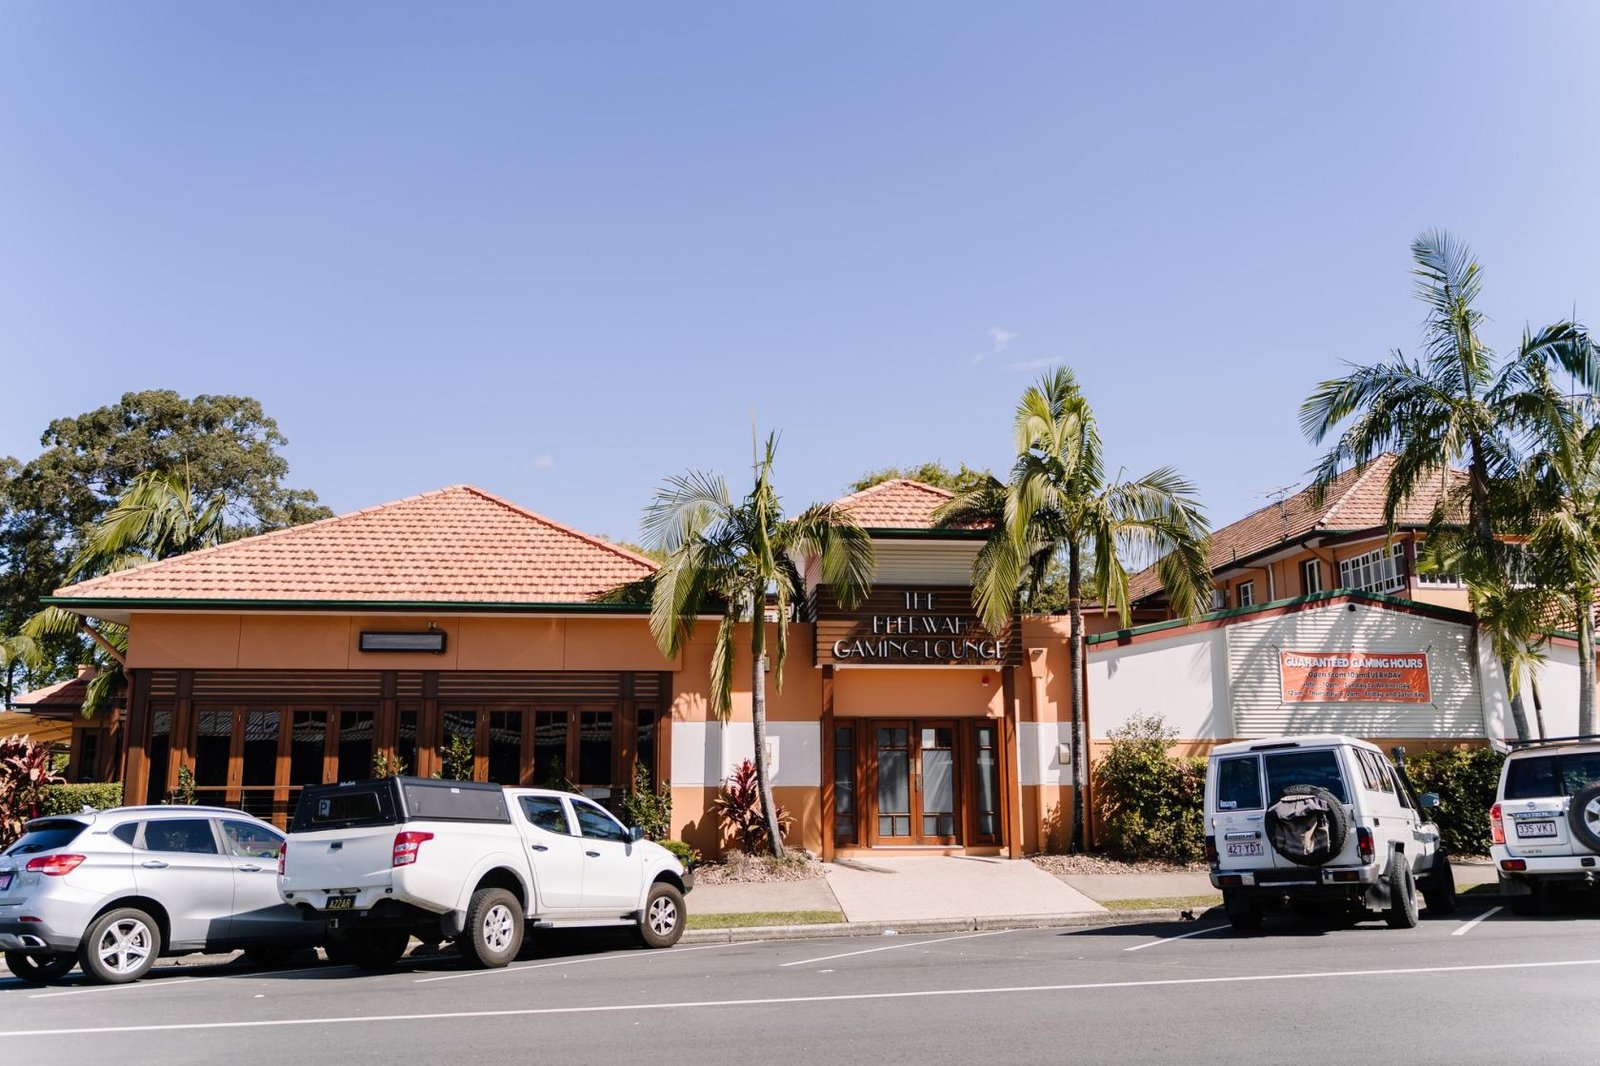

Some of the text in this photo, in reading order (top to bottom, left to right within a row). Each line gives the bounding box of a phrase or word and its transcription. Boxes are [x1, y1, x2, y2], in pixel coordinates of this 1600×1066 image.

[904, 592, 936, 610] THE
[833, 639, 1007, 659] GAMING LOUNGE
[1286, 658, 1424, 669] GUARANTEED GAMING HOURS
[1308, 671, 1327, 680] Open
[1328, 671, 1346, 679] from
[1367, 671, 1402, 679] EVERYDAY
[320, 802, 328, 815] P
